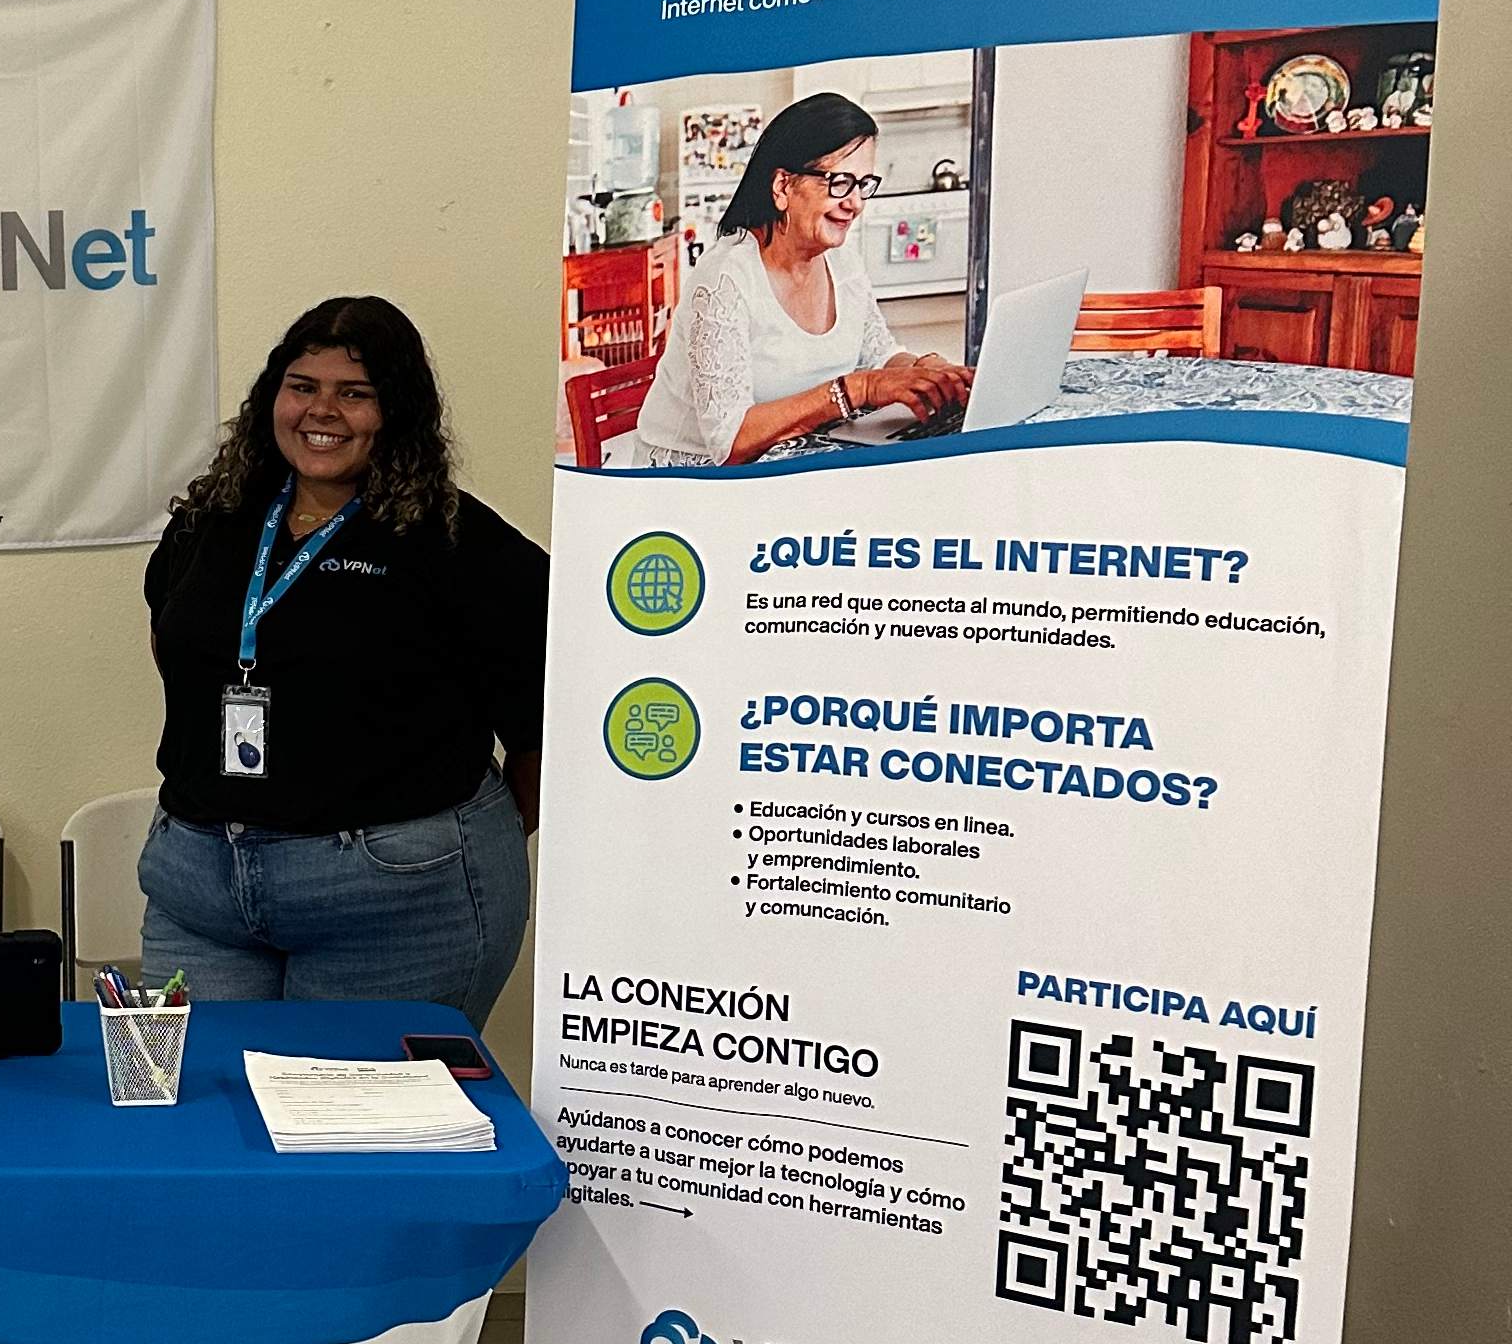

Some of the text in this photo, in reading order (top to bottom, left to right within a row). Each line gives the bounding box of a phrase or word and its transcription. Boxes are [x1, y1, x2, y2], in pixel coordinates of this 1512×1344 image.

[750, 530, 1248, 584] ¿QUÉ ES EL INTERNET?
[744, 618, 1115, 649] comuncación y nuevas oportunidades.
[746, 593, 1326, 638] Es una red que conecta al mundo, permitiendo educación,
[740, 695, 1154, 751] ¿PORQUÉ IMPORTA
[739, 741, 1219, 810] ESTAR CONECTADOS?
[749, 825, 980, 859] Oportunidades laborales
[750, 801, 1015, 838] Educación y cursos en linea.
[748, 853, 920, 879] y emprendimiento.
[745, 901, 889, 926] y comuncación.
[747, 874, 1011, 914] Fortalecimiento comunitario
[563, 972, 790, 1022] LA CONEXIÓN
[1017, 970, 1318, 1039] PARTICIPA AQUÍ
[562, 1014, 879, 1086] EMPIEZA CONTIGO
[559, 1054, 876, 1109] Nunca es tarde para aprender algo nuevo.
[557, 1107, 904, 1173] Ayúdanos a conocer cómo podemos
[557, 1136, 966, 1211] ayudarte a usar mejor la tecnología y cómo
[563, 1161, 943, 1234] poyar a tu comunidad con herramientas
